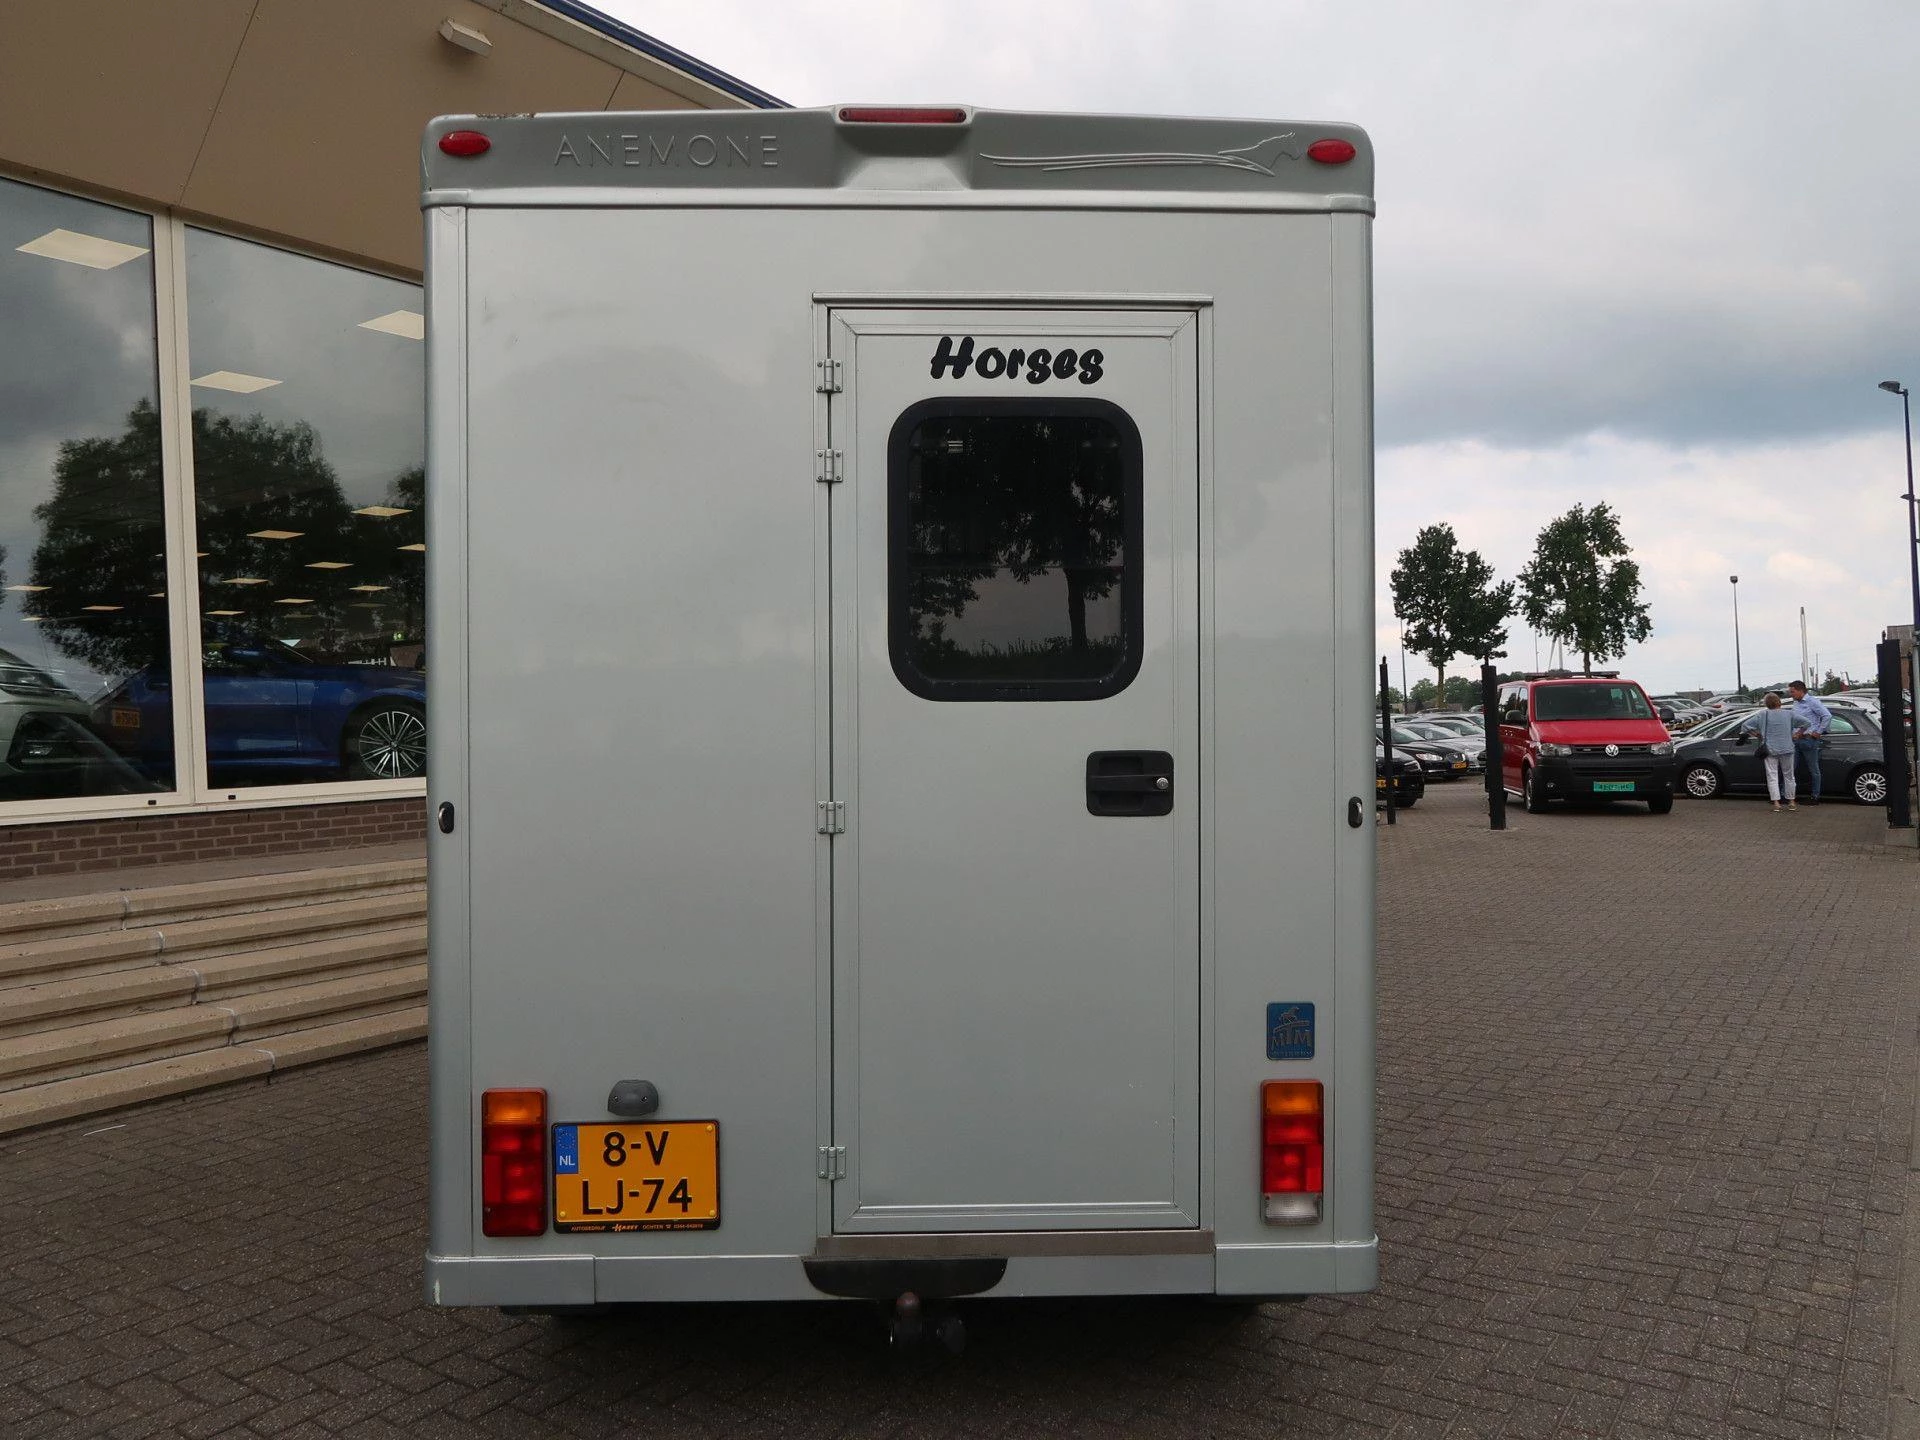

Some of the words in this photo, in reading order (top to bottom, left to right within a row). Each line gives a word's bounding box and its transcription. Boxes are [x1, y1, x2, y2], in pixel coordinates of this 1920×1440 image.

[555, 134, 778, 167] ANEMONE
[930, 336, 1104, 384] Horses
[559, 1155, 575, 1166] NL
[603, 1130, 669, 1166] 8-V
[582, 1177, 693, 1215] LJ-74
